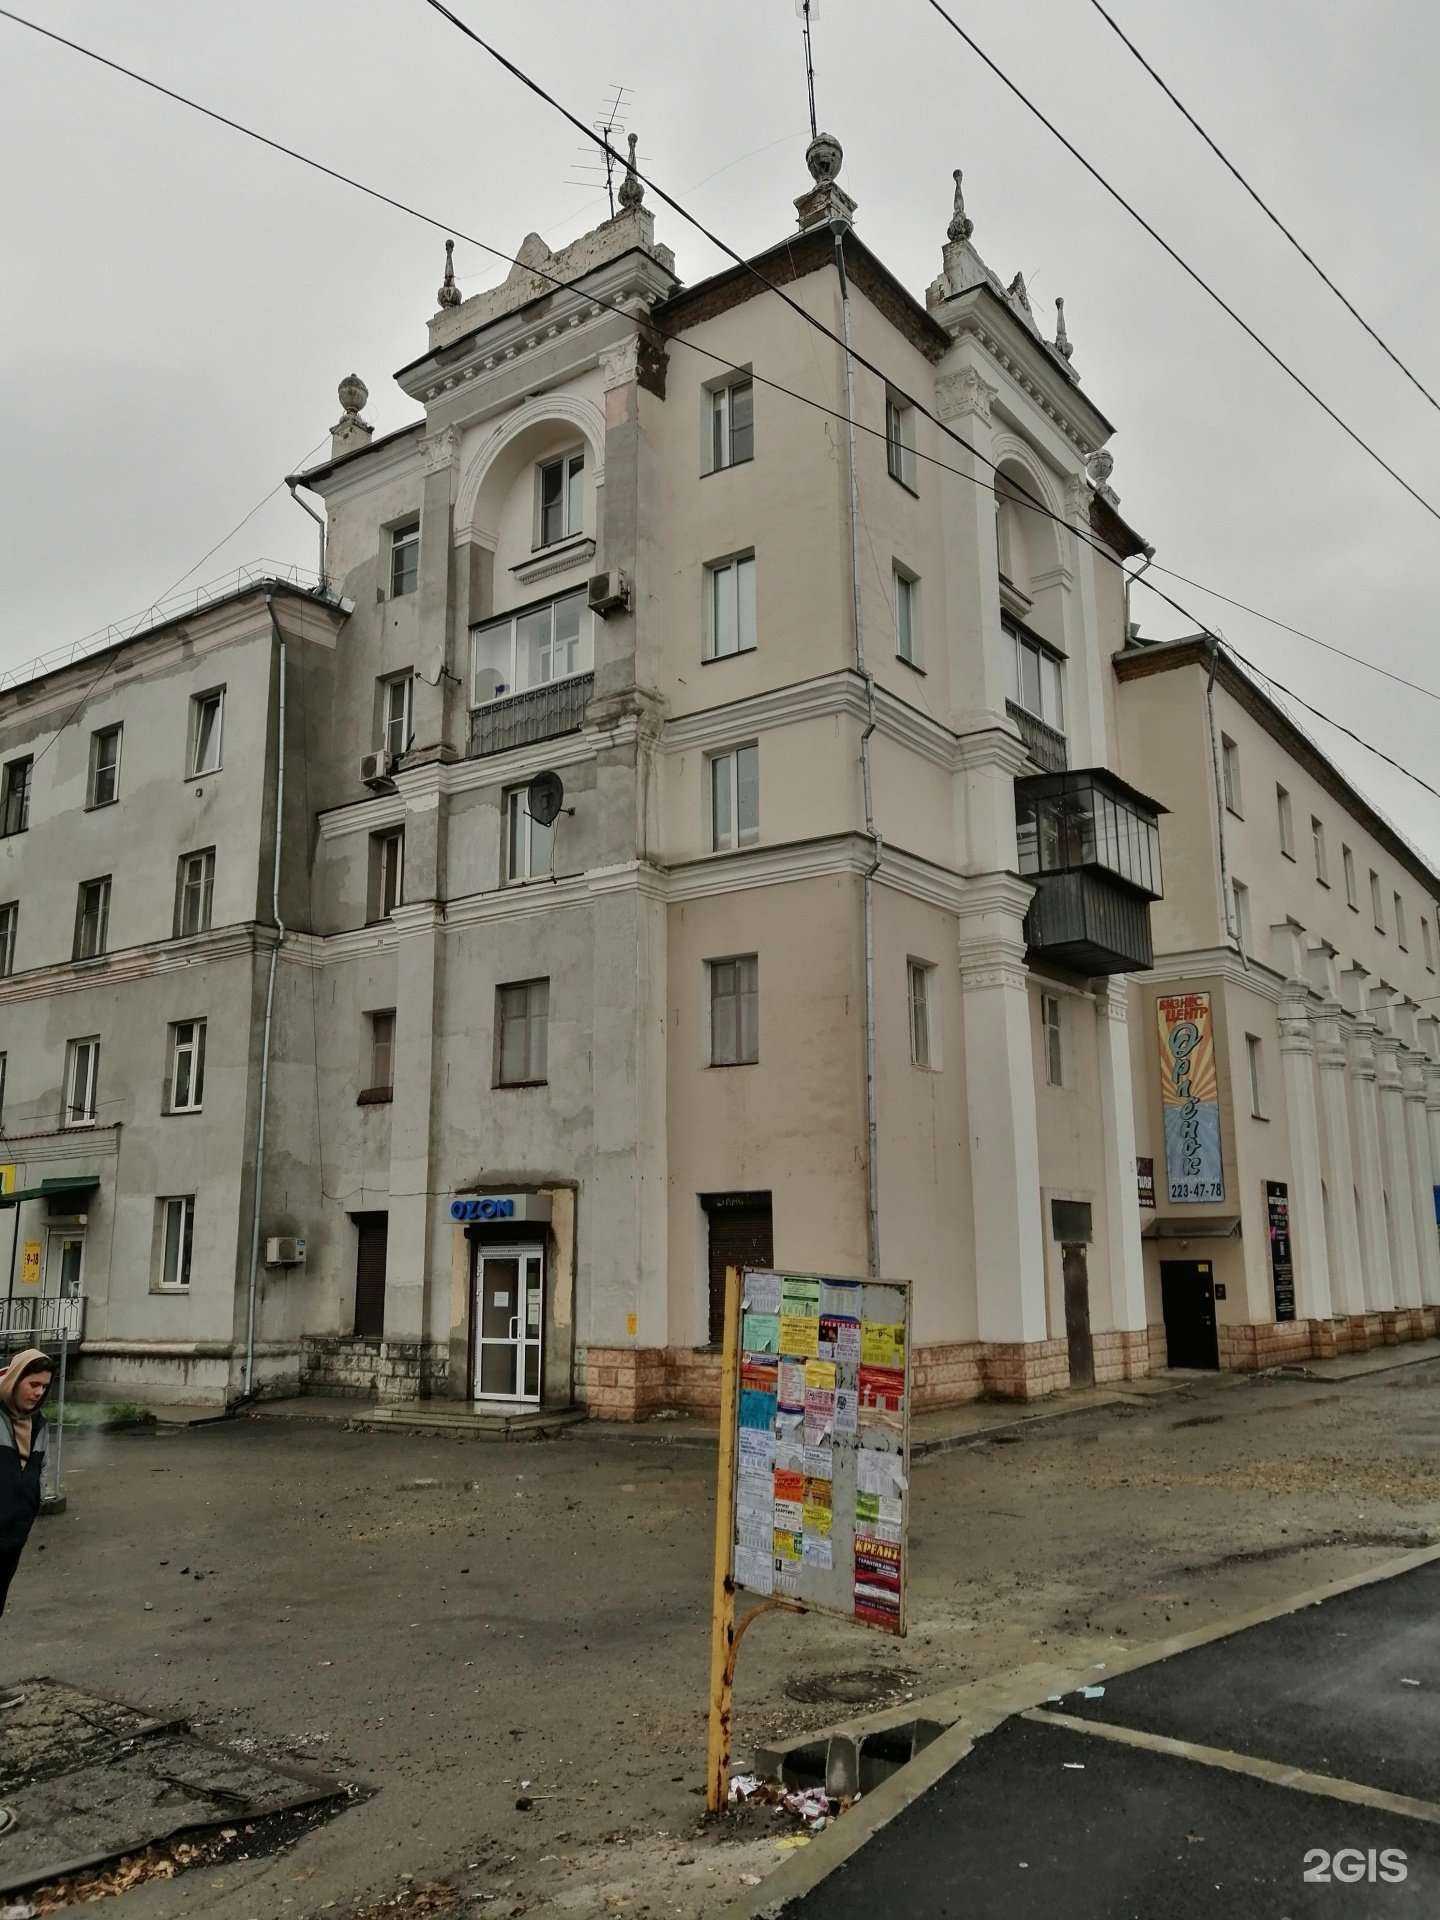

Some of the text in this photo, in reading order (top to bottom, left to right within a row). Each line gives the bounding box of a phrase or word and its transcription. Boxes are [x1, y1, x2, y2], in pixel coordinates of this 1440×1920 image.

[1160, 996, 1203, 1010] БИЗНЕС
[1166, 1007, 1209, 1022] ЦЕНТР
[1172, 1183, 1222, 1198] 223-47-78
[450, 1199, 514, 1221] OZON
